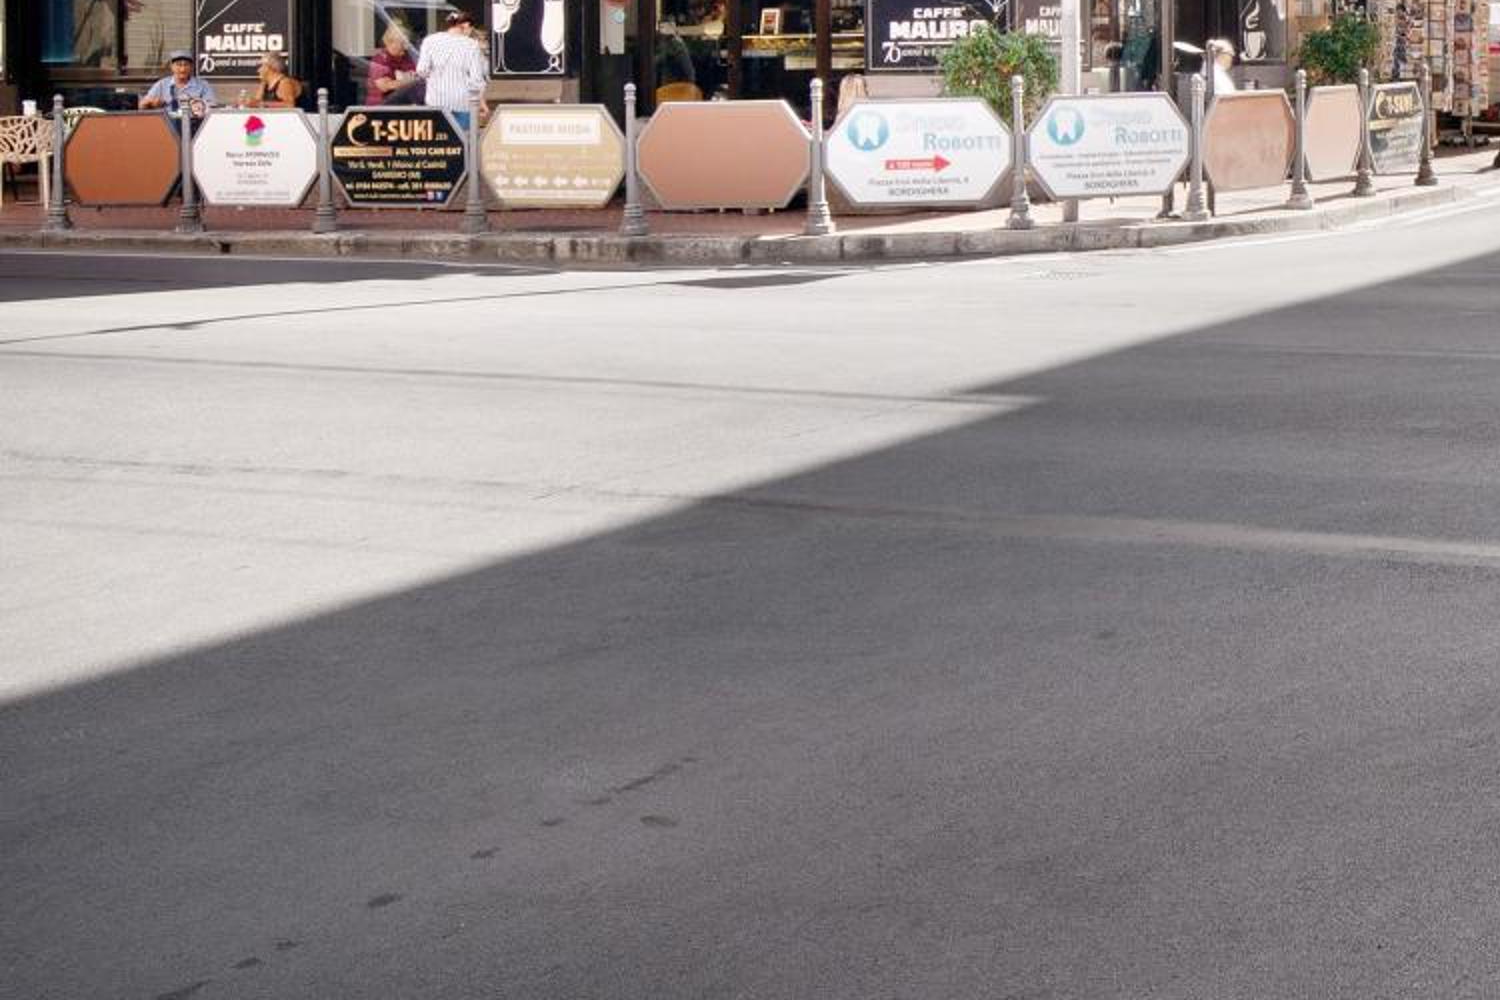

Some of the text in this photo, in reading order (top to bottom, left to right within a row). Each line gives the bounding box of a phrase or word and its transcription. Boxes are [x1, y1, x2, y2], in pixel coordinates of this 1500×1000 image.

[205, 33, 283, 51] MAURO
[371, 119, 433, 141] T-SUKI
[411, 147, 427, 156] YOU
